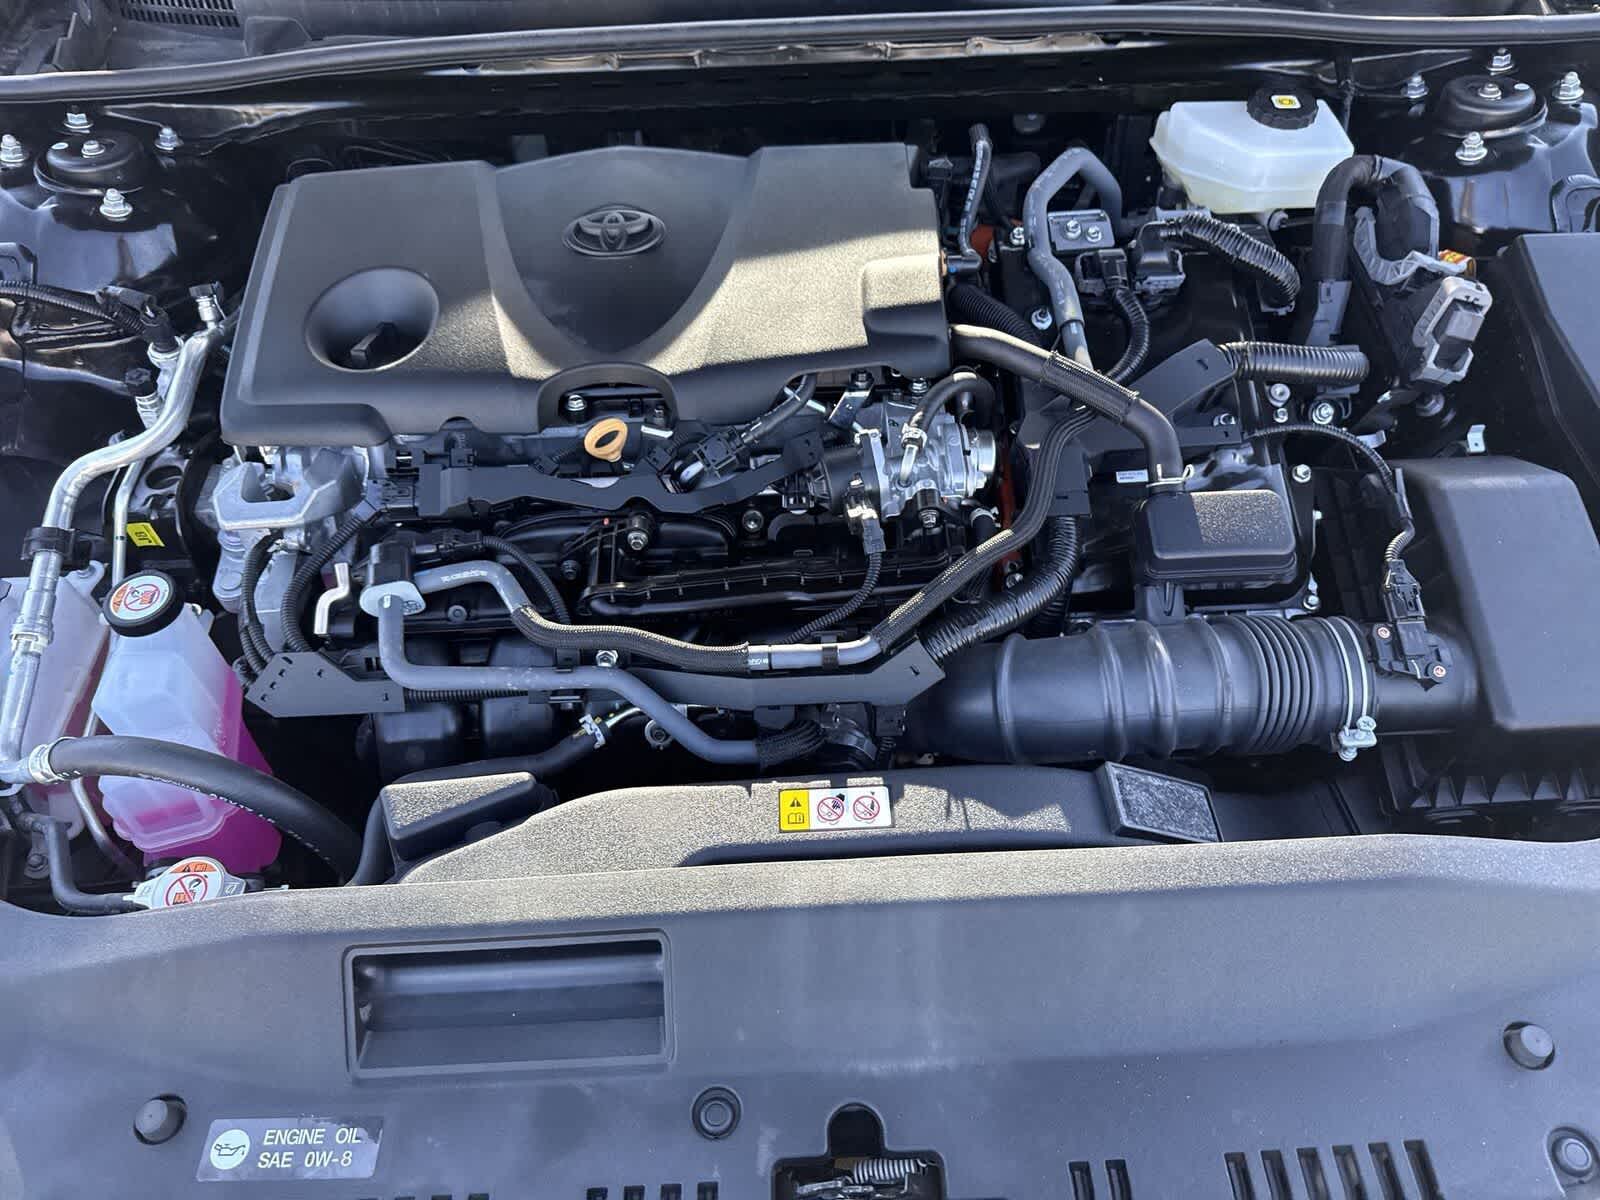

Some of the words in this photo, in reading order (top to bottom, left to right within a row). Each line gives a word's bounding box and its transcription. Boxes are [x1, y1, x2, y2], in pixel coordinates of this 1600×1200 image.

[263, 1128, 326, 1145] ENGINE
[335, 1127, 361, 1144] OIL
[257, 1151, 294, 1169] SAE
[304, 1151, 353, 1168] 0W-8
